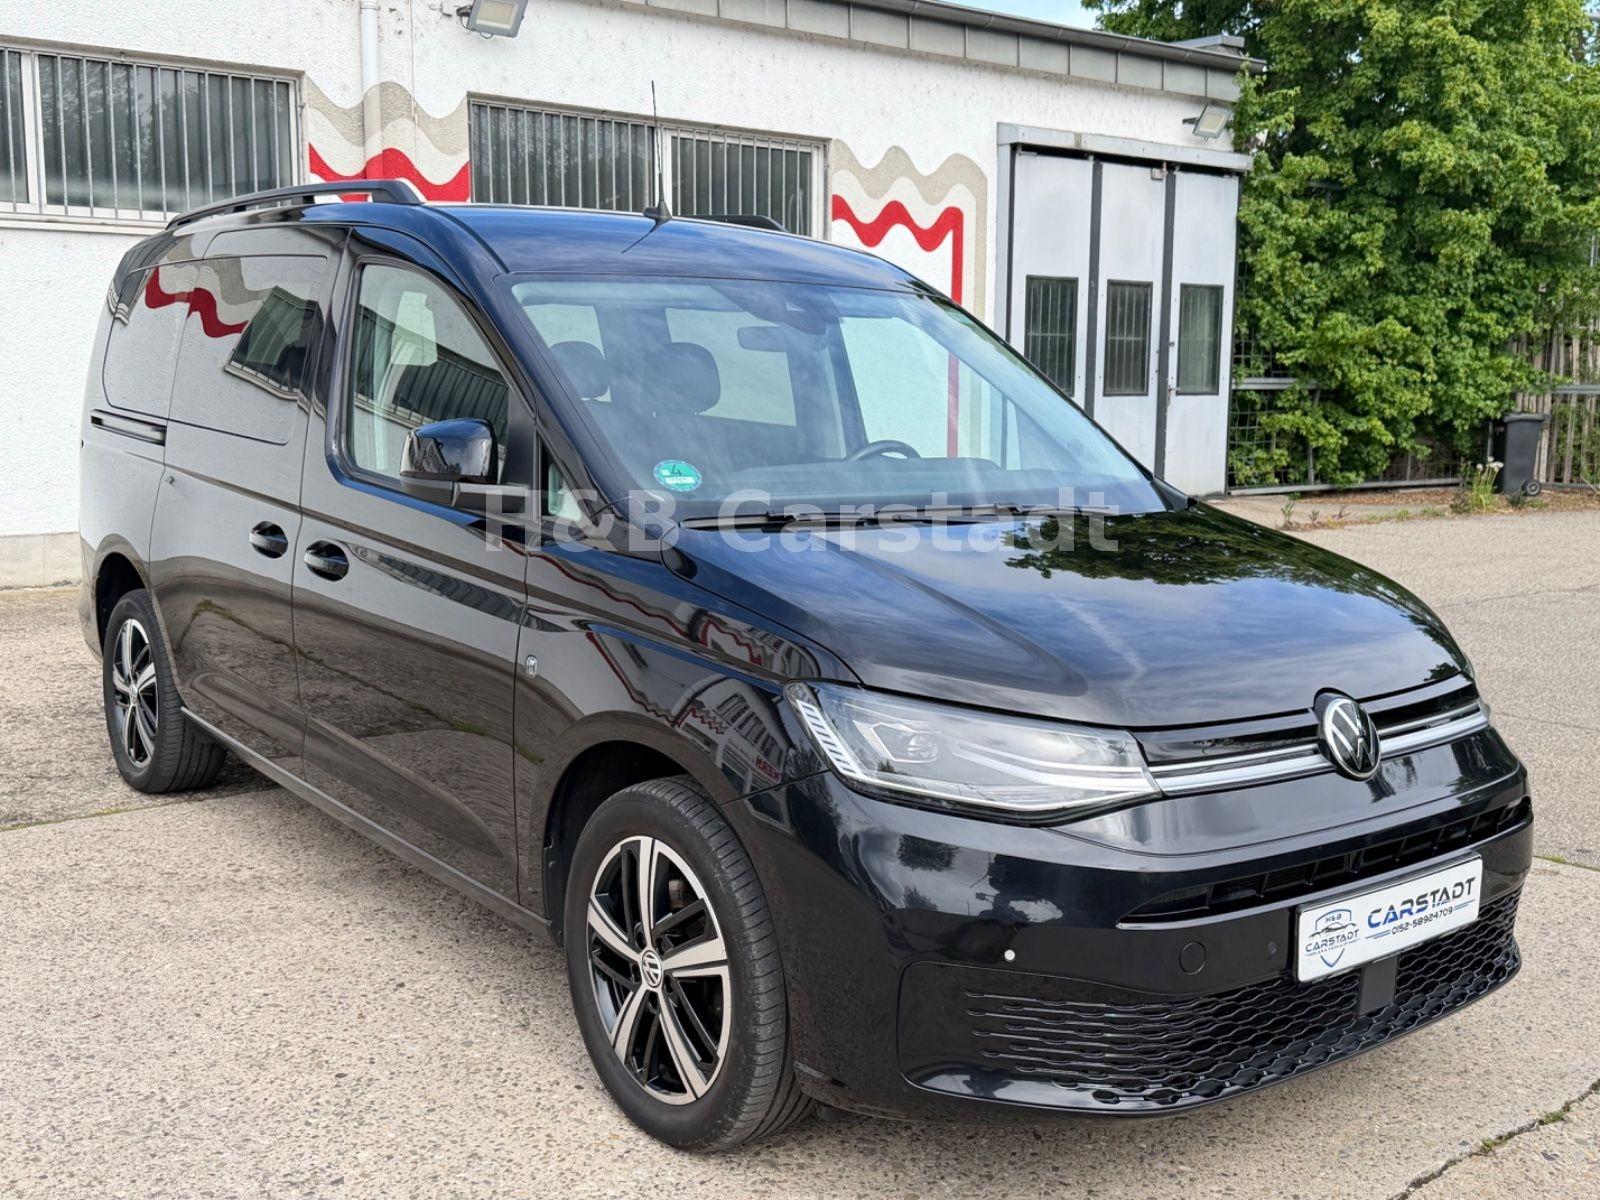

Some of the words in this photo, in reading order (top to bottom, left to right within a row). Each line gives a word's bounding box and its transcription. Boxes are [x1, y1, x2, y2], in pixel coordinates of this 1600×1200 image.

[671, 464, 682, 476] 4
[1368, 876, 1476, 928] CARSTADT
[1305, 929, 1359, 952] CARSTADT
